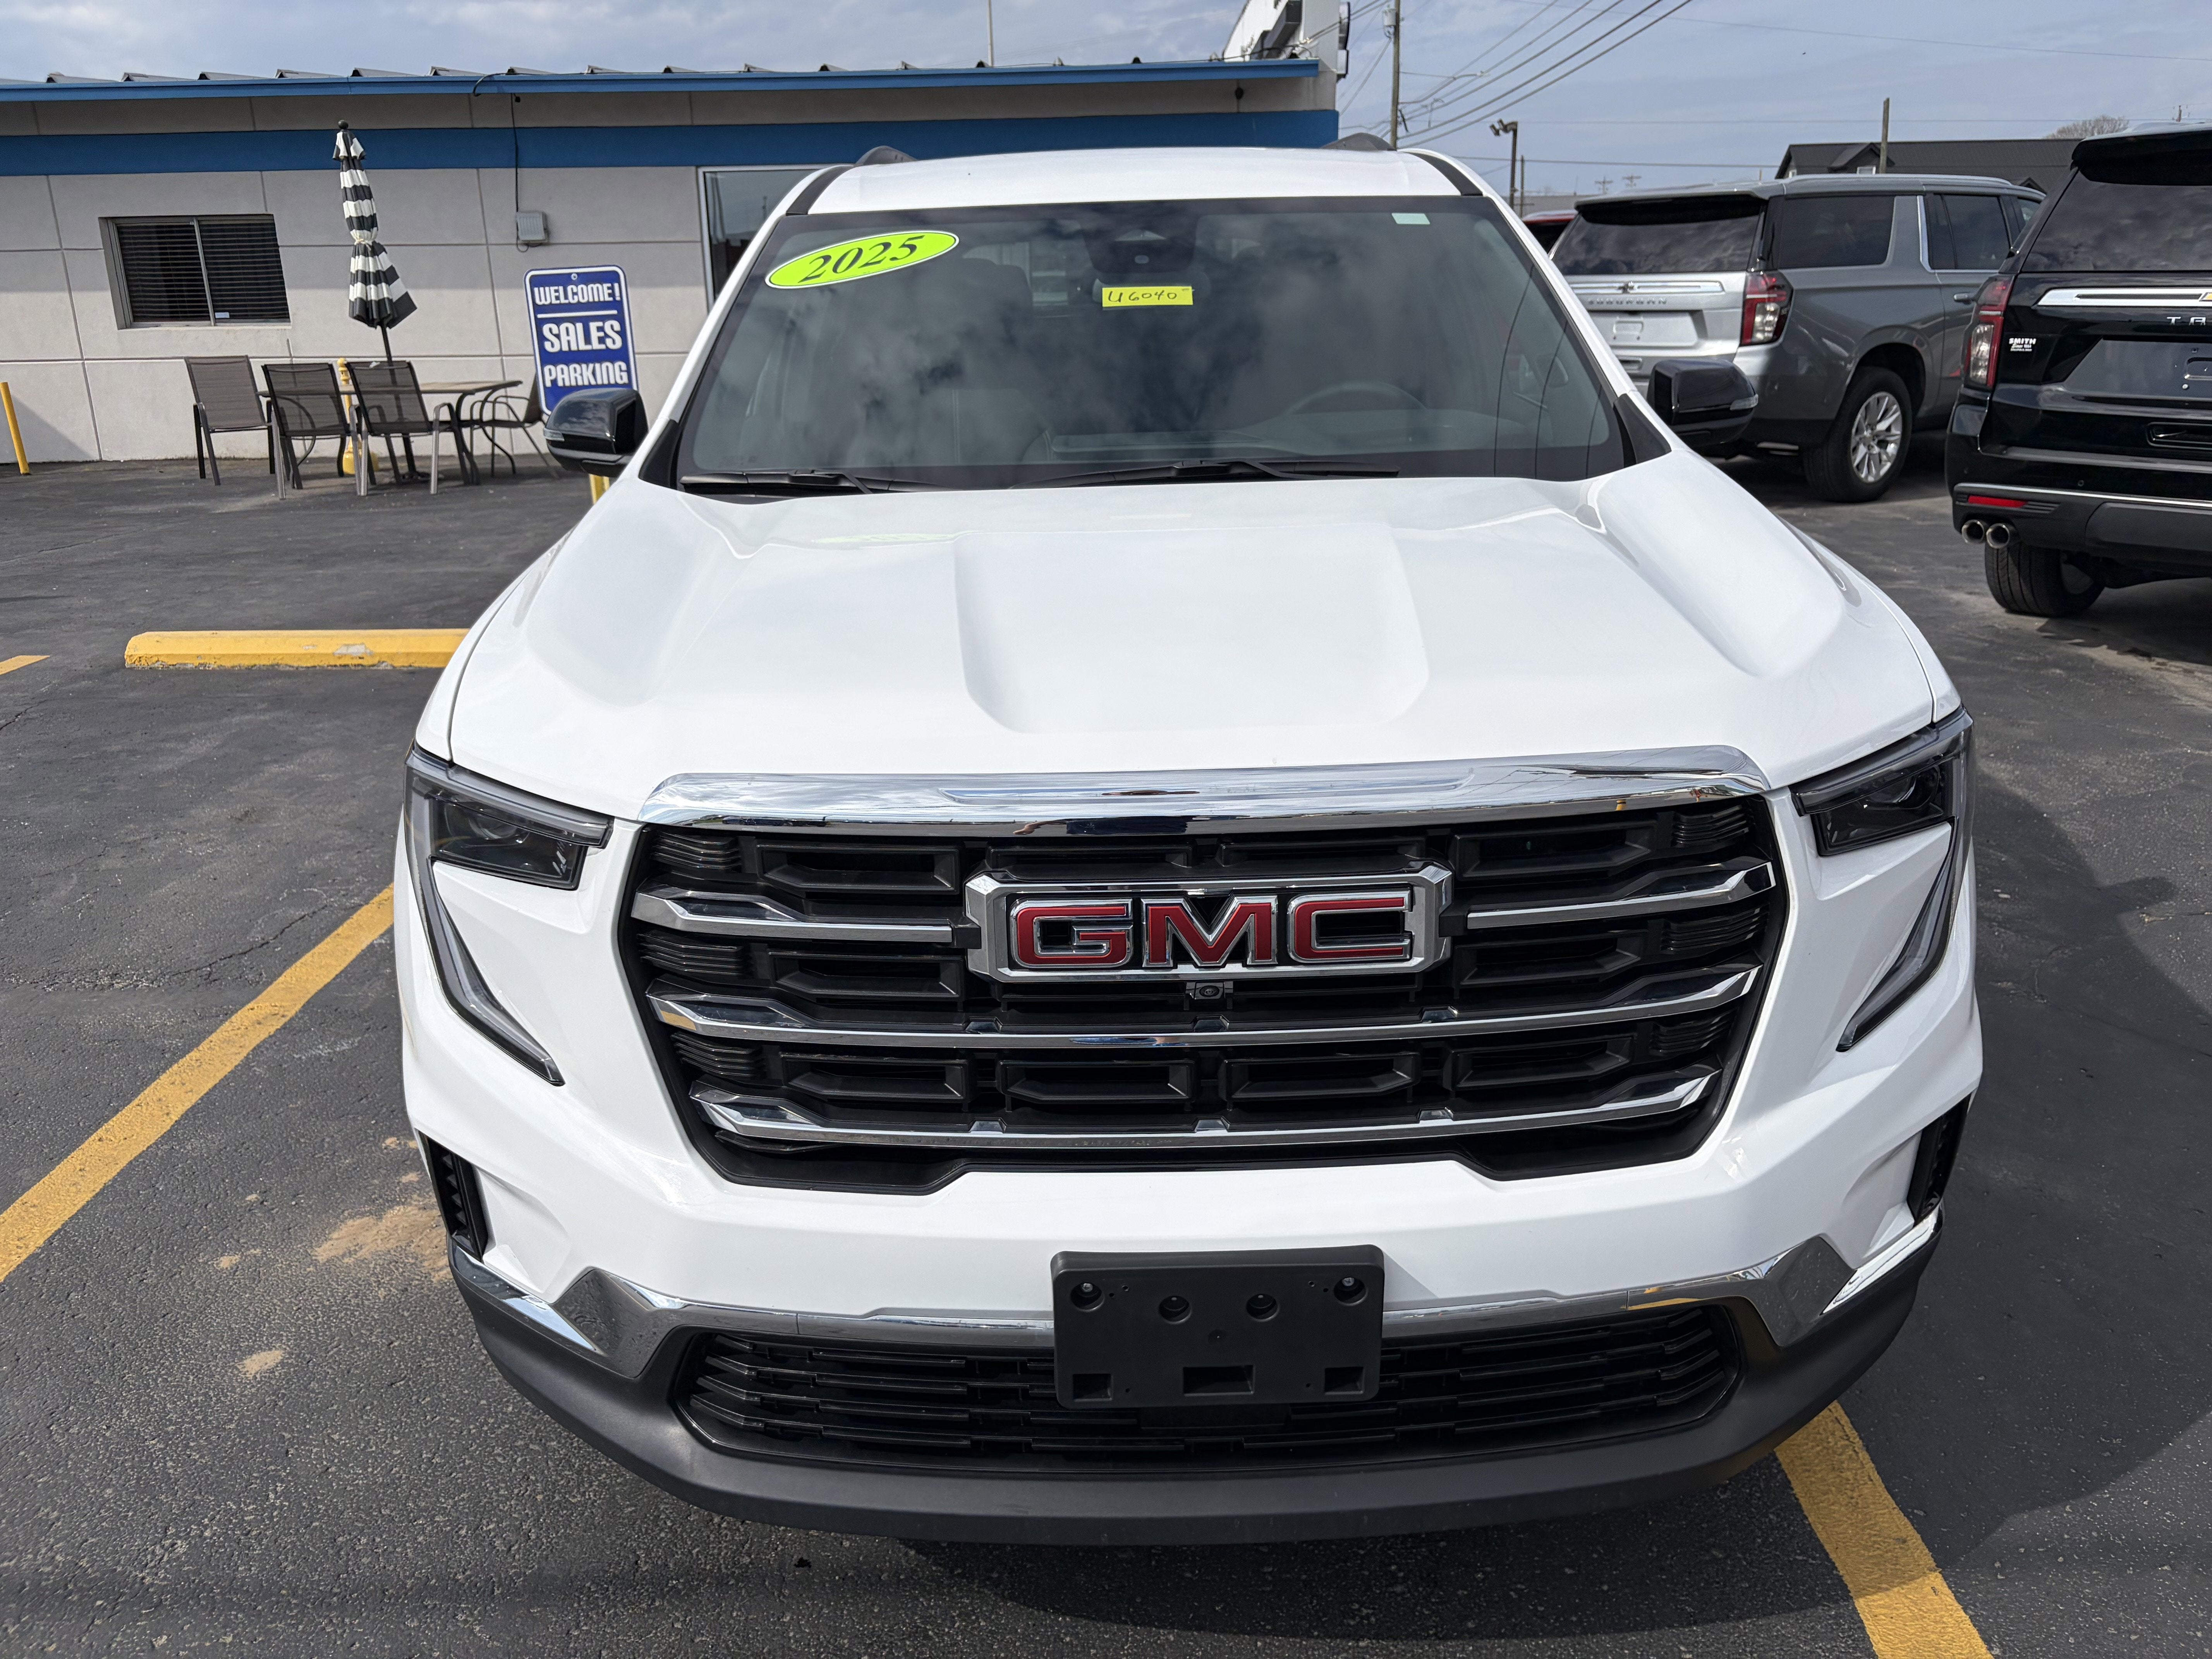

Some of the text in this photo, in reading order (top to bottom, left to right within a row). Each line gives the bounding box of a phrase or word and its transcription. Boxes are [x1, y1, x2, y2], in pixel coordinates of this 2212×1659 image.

[798, 235, 926, 284] 2025
[534, 283, 621, 305] WELCOME!
[543, 320, 622, 352] SALES
[544, 362, 629, 387] PARKING
[1010, 894, 1412, 968] GMC
